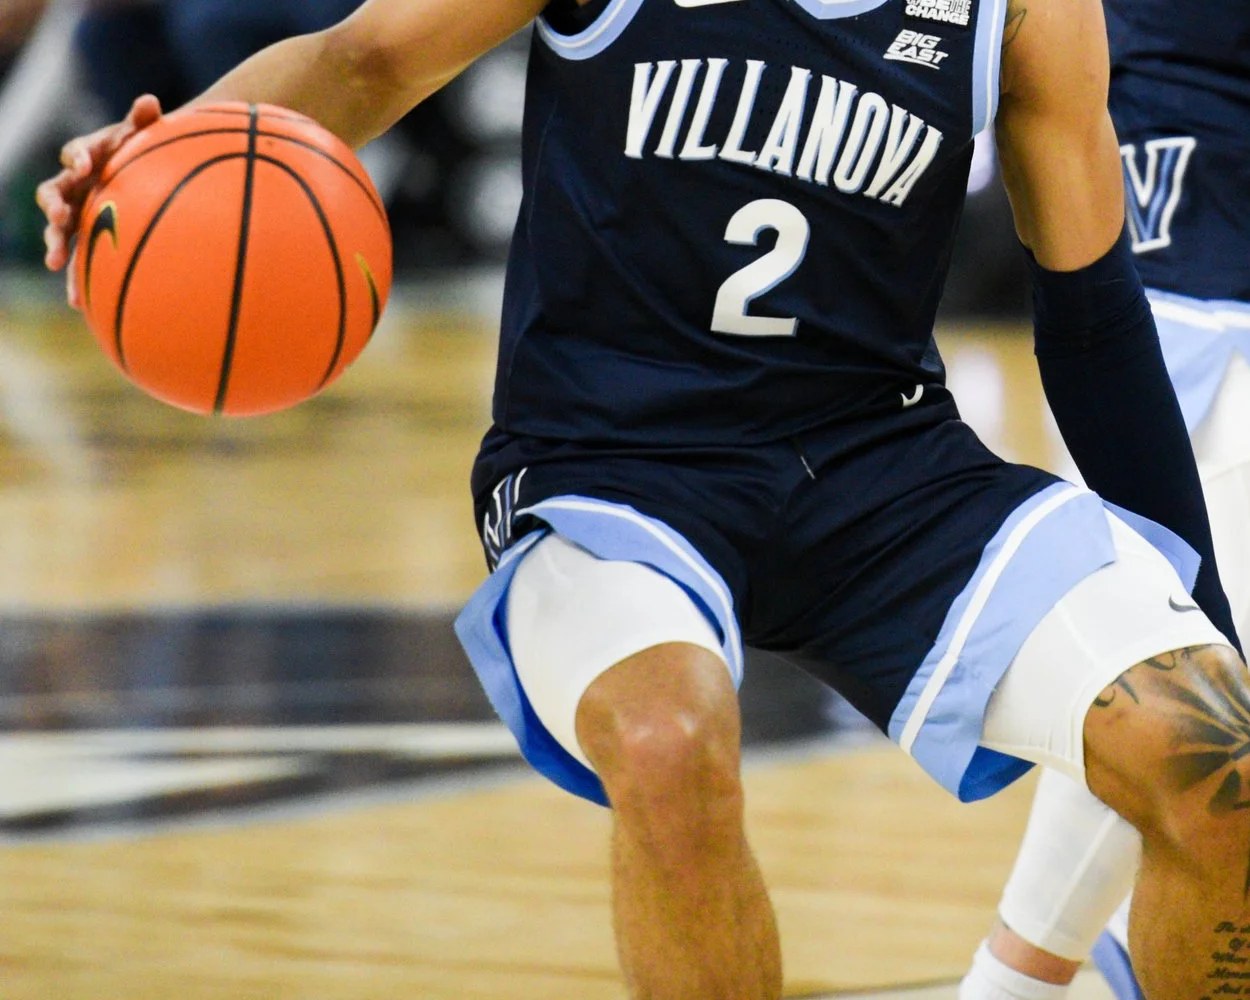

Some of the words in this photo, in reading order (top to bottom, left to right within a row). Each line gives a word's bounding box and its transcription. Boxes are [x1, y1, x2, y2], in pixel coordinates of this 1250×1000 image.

[895, 29, 942, 50] BIG
[904, 4, 970, 26] CHANGE
[886, 41, 949, 64] EAST
[624, 57, 944, 208] VILLANOVA
[1119, 136, 1197, 253] V
[710, 198, 811, 337] 2
